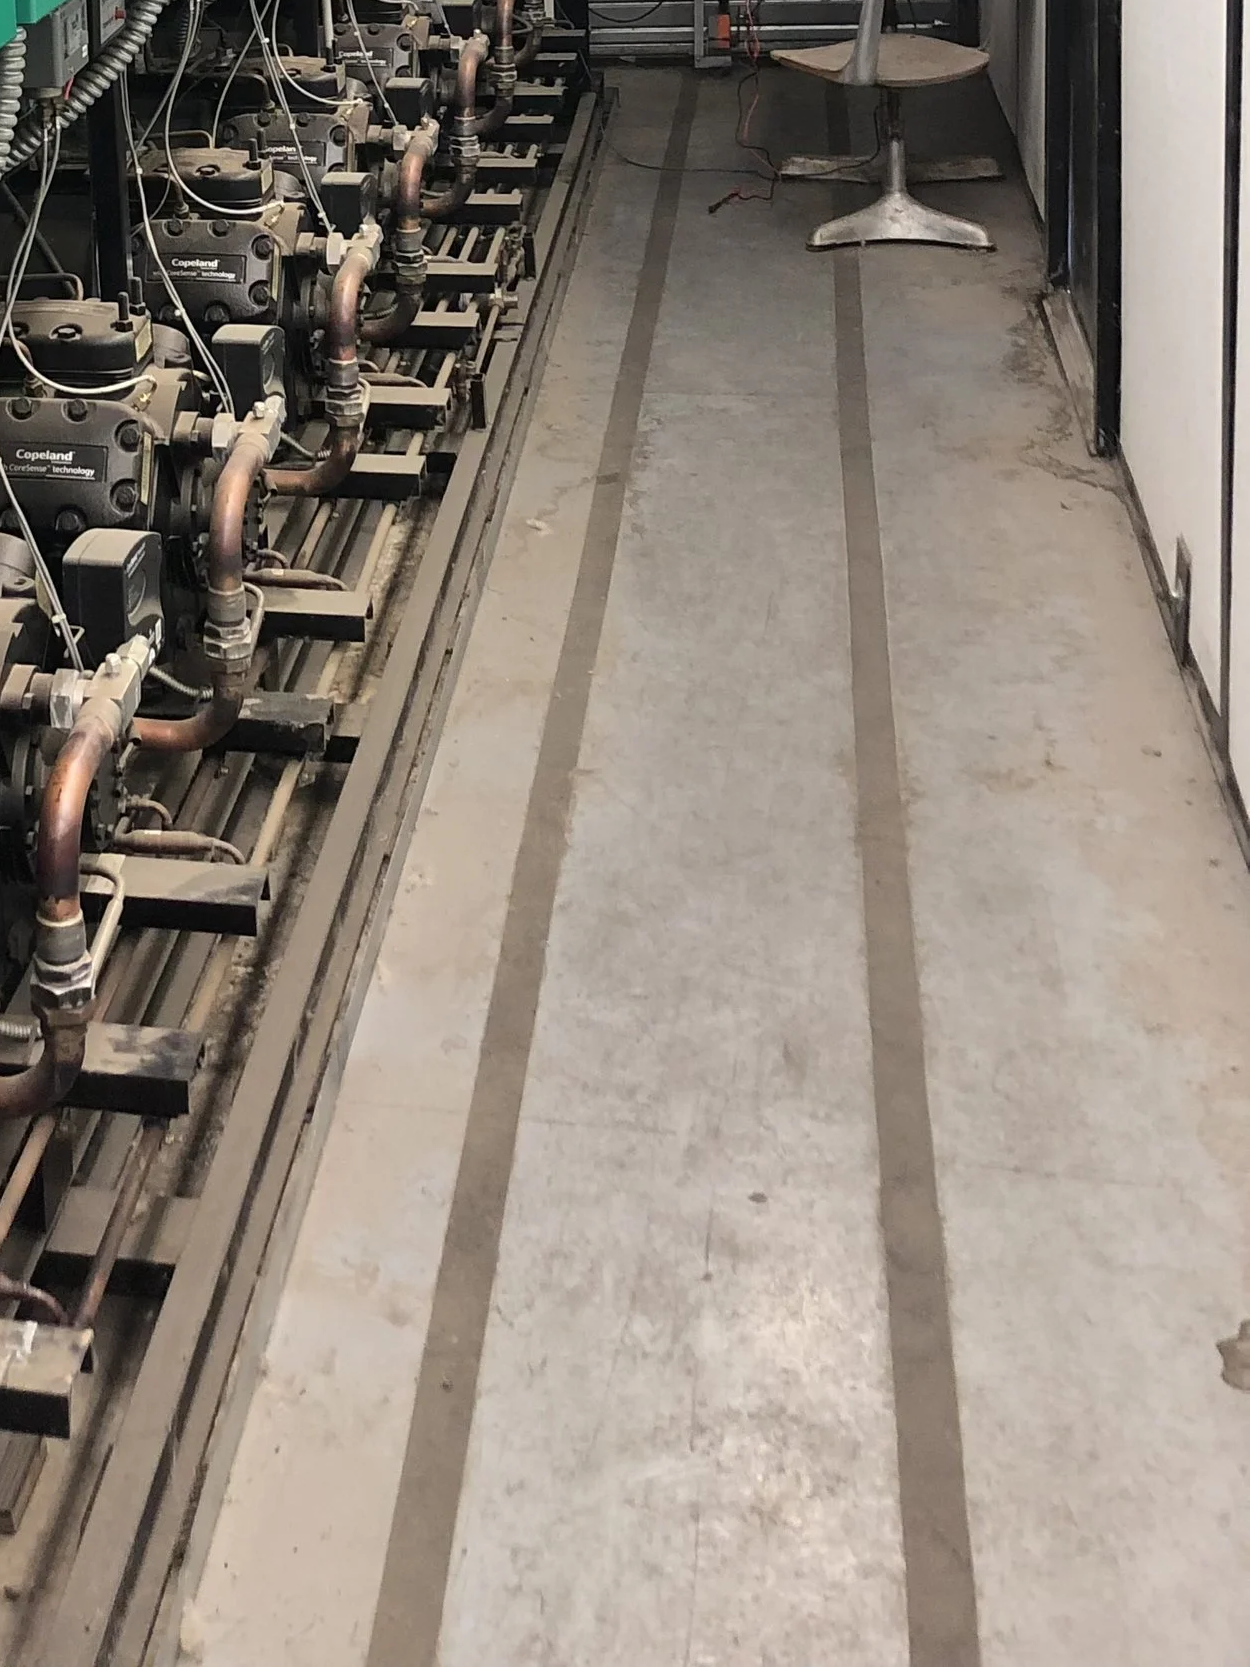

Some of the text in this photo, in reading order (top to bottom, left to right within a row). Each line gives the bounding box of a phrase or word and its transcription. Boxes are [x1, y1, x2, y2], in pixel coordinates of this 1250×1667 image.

[171, 258, 220, 268] Copeland
[15, 448, 76, 462] Copeland
[52, 465, 95, 477] technology
